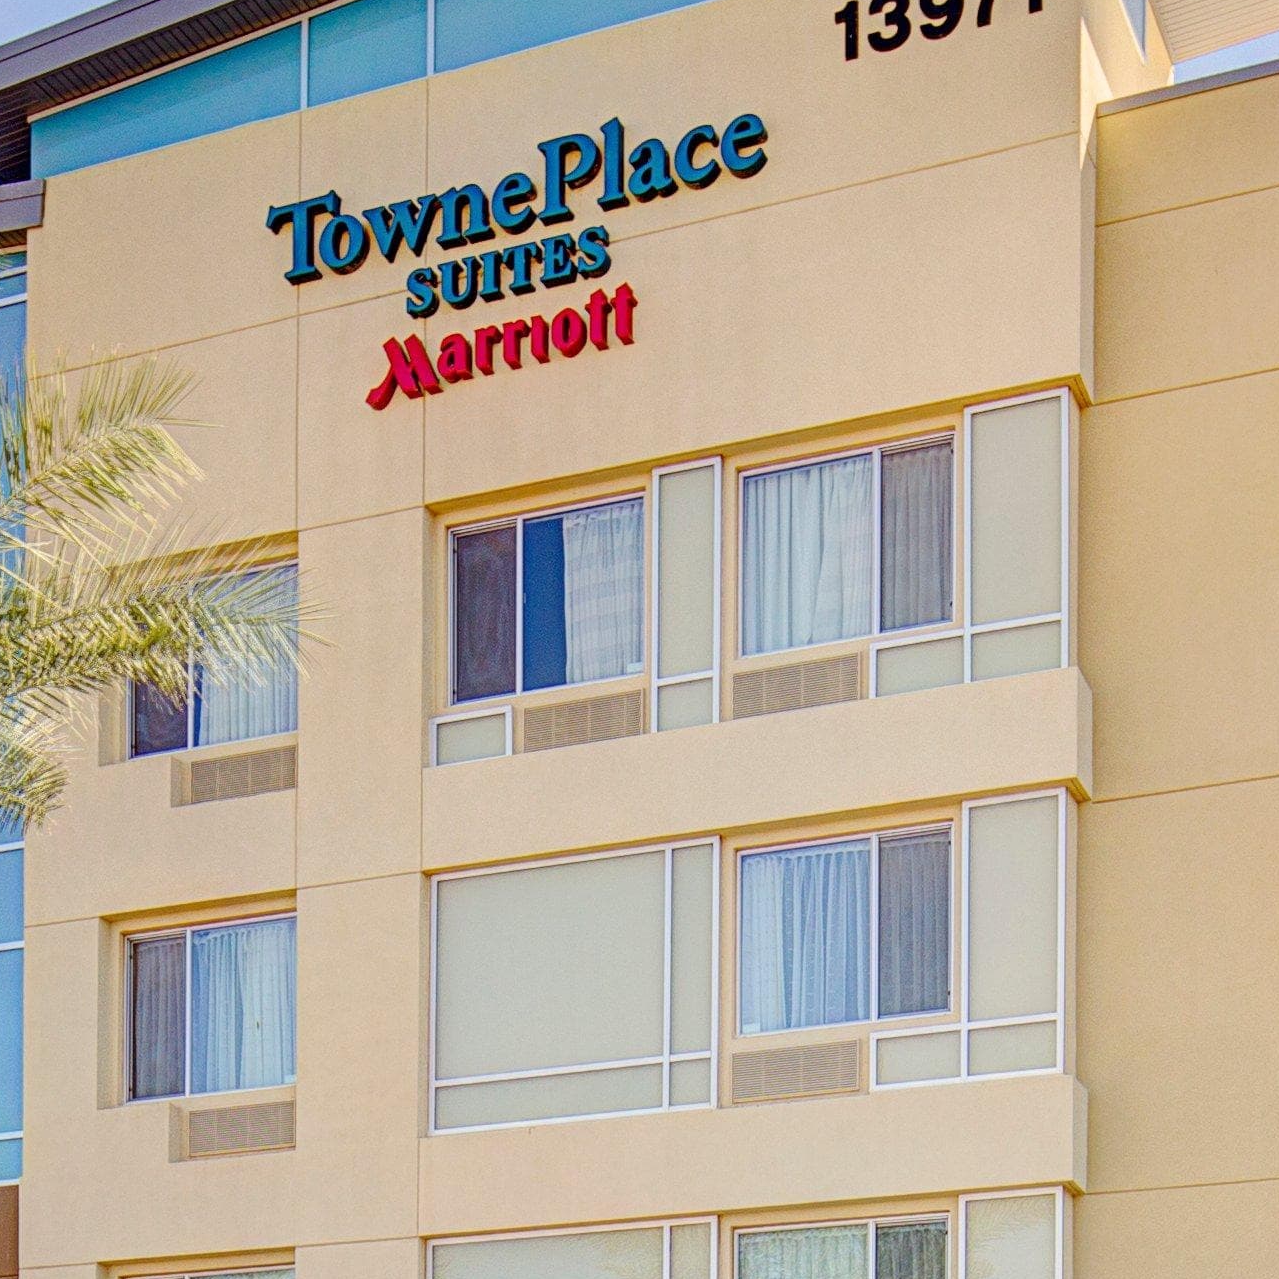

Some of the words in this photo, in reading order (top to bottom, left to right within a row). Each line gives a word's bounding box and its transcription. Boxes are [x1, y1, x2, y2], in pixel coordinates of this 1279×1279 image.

[267, 113, 768, 285] TownePlace
[406, 225, 610, 319] SUITES
[365, 283, 638, 411] Marriott
